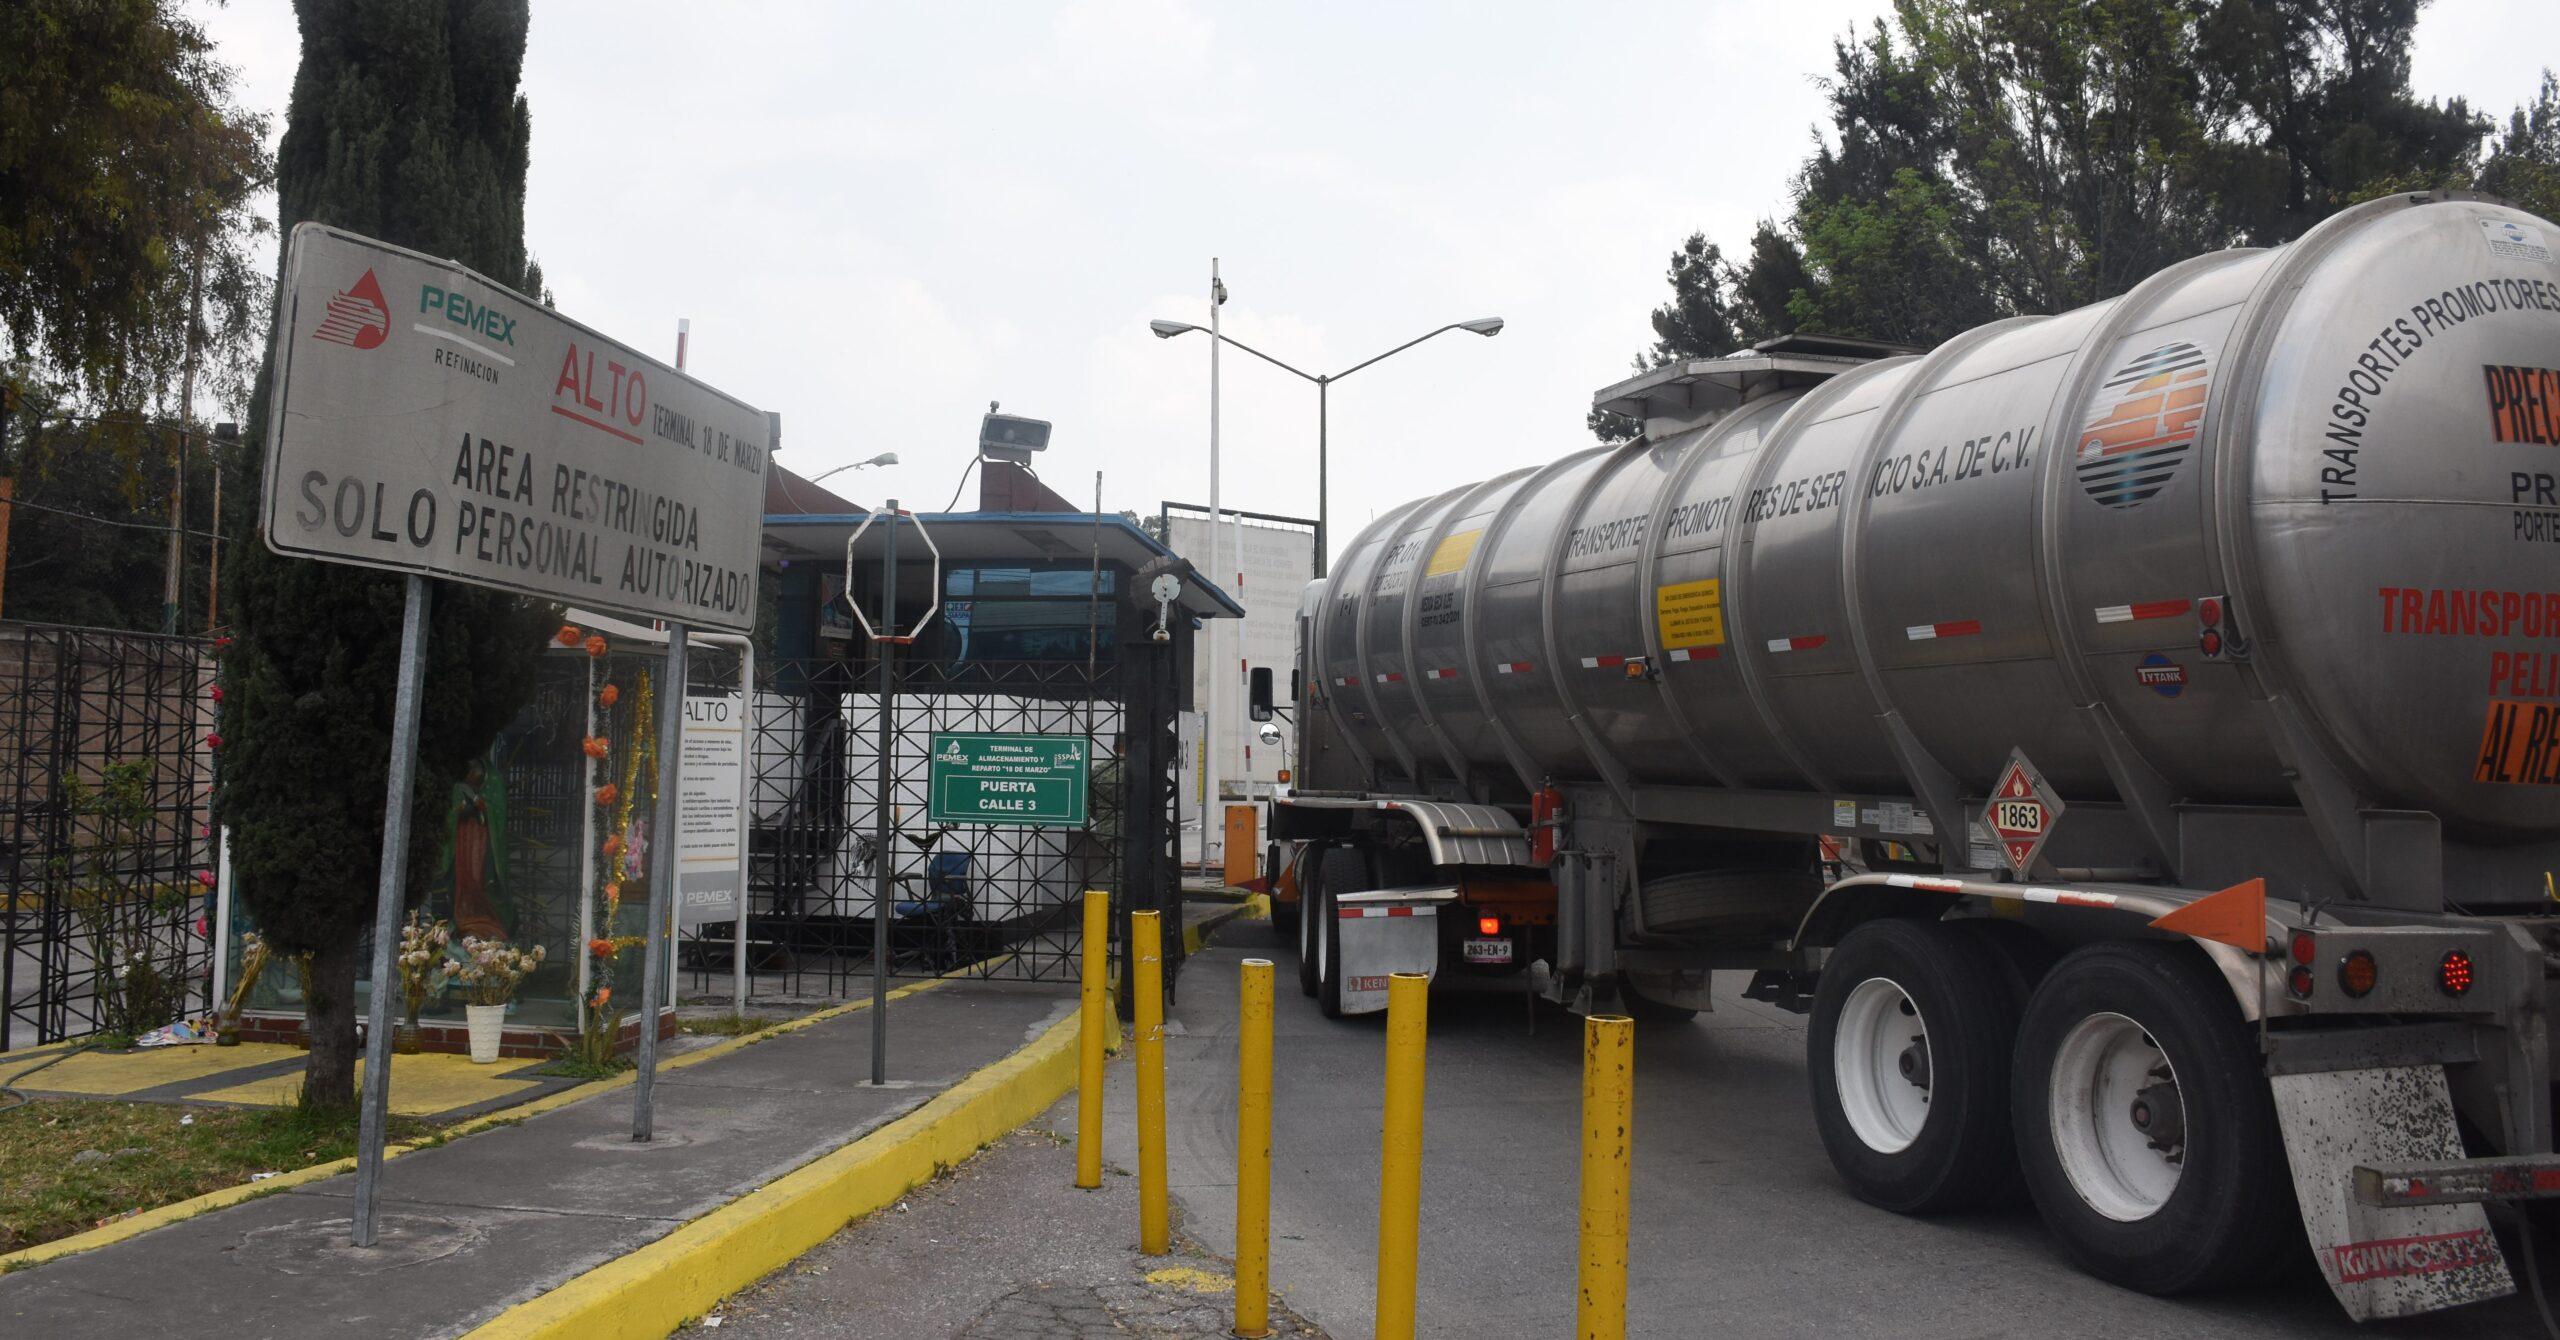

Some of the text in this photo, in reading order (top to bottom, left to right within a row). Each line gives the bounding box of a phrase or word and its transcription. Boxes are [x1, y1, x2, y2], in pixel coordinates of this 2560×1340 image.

[419, 285, 518, 347] PEMEX
[434, 348, 499, 385] REFINACION
[555, 342, 647, 427] ALTO
[2321, 279, 2560, 505] TRANSPORTES PROMOTORES
[2484, 365, 2560, 446] PREC
[653, 402, 763, 476] TERMINAL 18 DE MARZO
[452, 432, 698, 552] AREA RESTRINGIDA
[1565, 513, 1649, 559] TRANSPORTE
[1779, 478, 1808, 517] DE
[1912, 446, 1948, 490] S.A.
[1955, 435, 1992, 480] DE
[1991, 425, 2036, 474] C.V.
[296, 470, 751, 616] SOLO PERSONAL AUTORIZADO
[2137, 667, 2182, 682] TYTANK
[685, 701, 728, 722] ALTO
[978, 755, 1039, 763] ALMACENAMIENTO
[990, 745, 1023, 753] TERMINAL
[2475, 703, 2560, 784] AL RE
[980, 781, 1036, 793] PUERTA
[979, 798, 1036, 811] CALLE 3
[2000, 804, 2038, 829] 1863
[2015, 846, 2023, 861] 3
[686, 889, 731, 904] PEMEX
[1364, 978, 1388, 989] KEN
